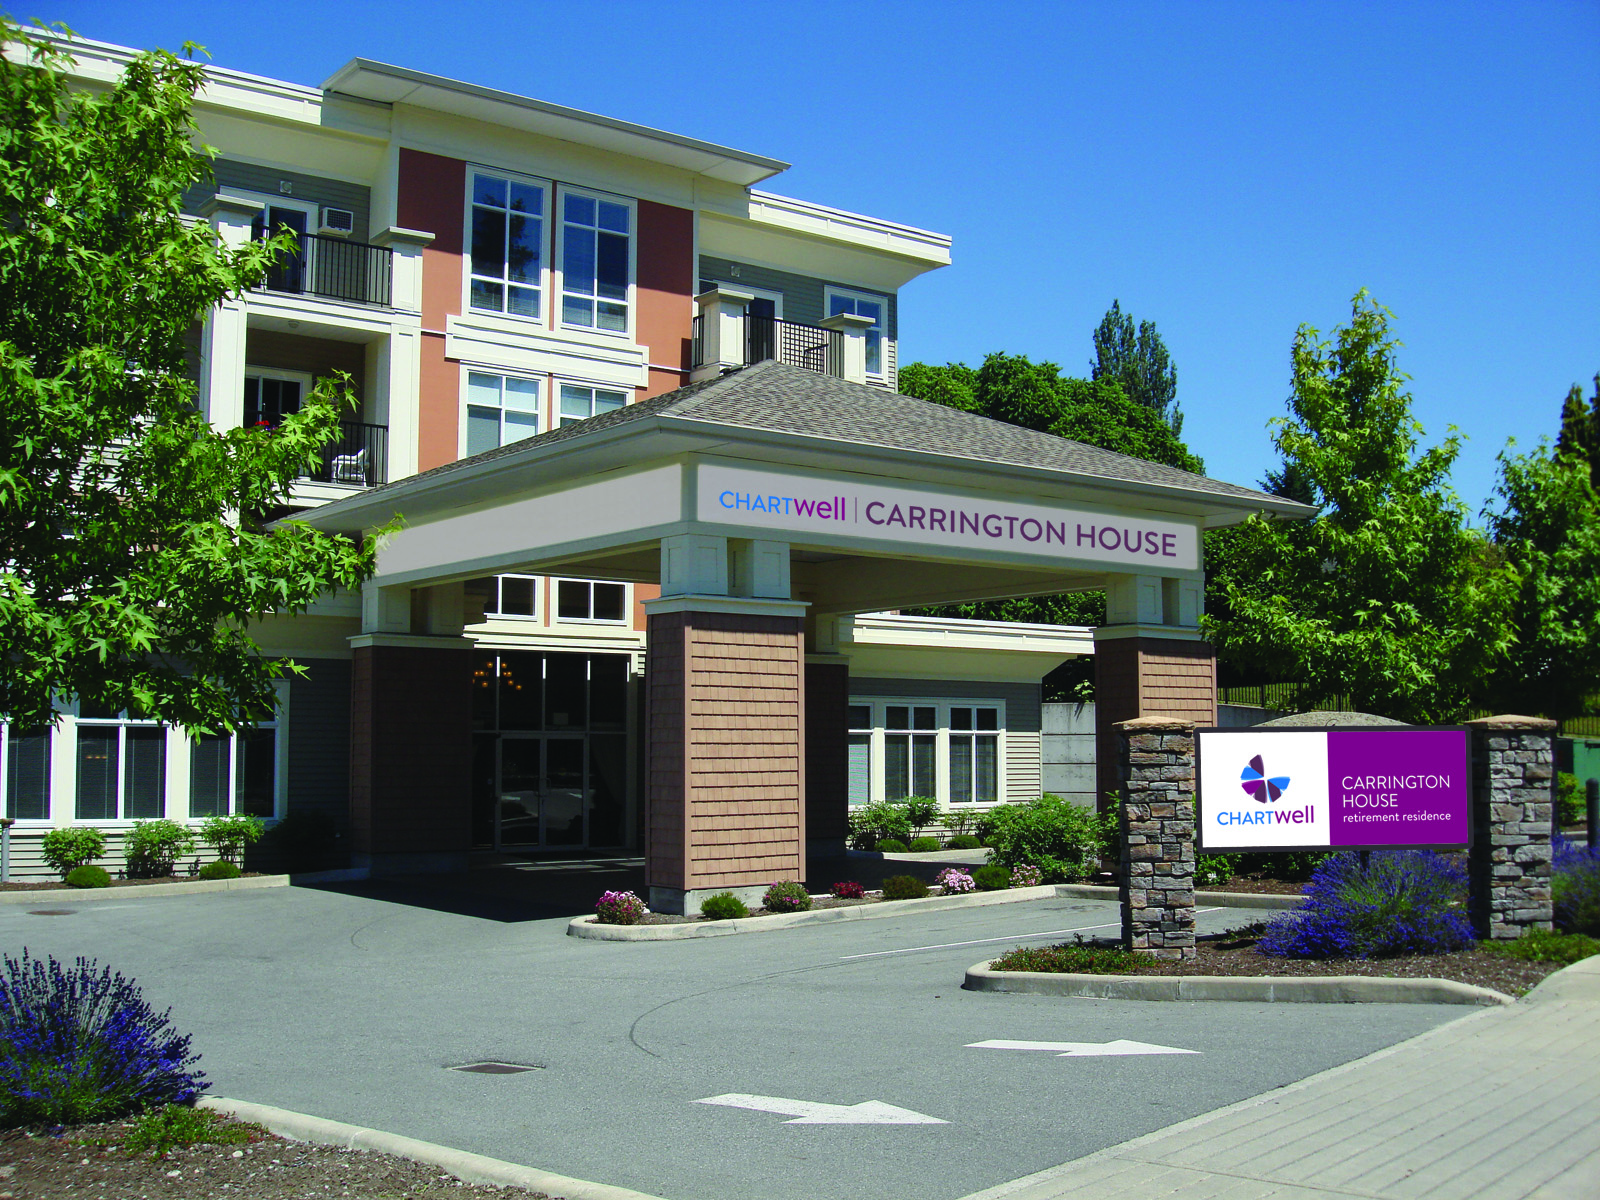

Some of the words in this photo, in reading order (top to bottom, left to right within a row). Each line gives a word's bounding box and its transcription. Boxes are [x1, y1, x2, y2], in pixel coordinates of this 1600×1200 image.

[719, 490, 846, 521] CHARTwell
[865, 501, 1066, 545] CARRINGTON
[1076, 523, 1177, 557] HOUSE
[1342, 775, 1450, 790] CARRINGTON
[1342, 793, 1399, 808] HOUSE
[1217, 805, 1314, 825] CHARTwell
[1343, 812, 1399, 822] retirement
[1402, 811, 1452, 822] residence
